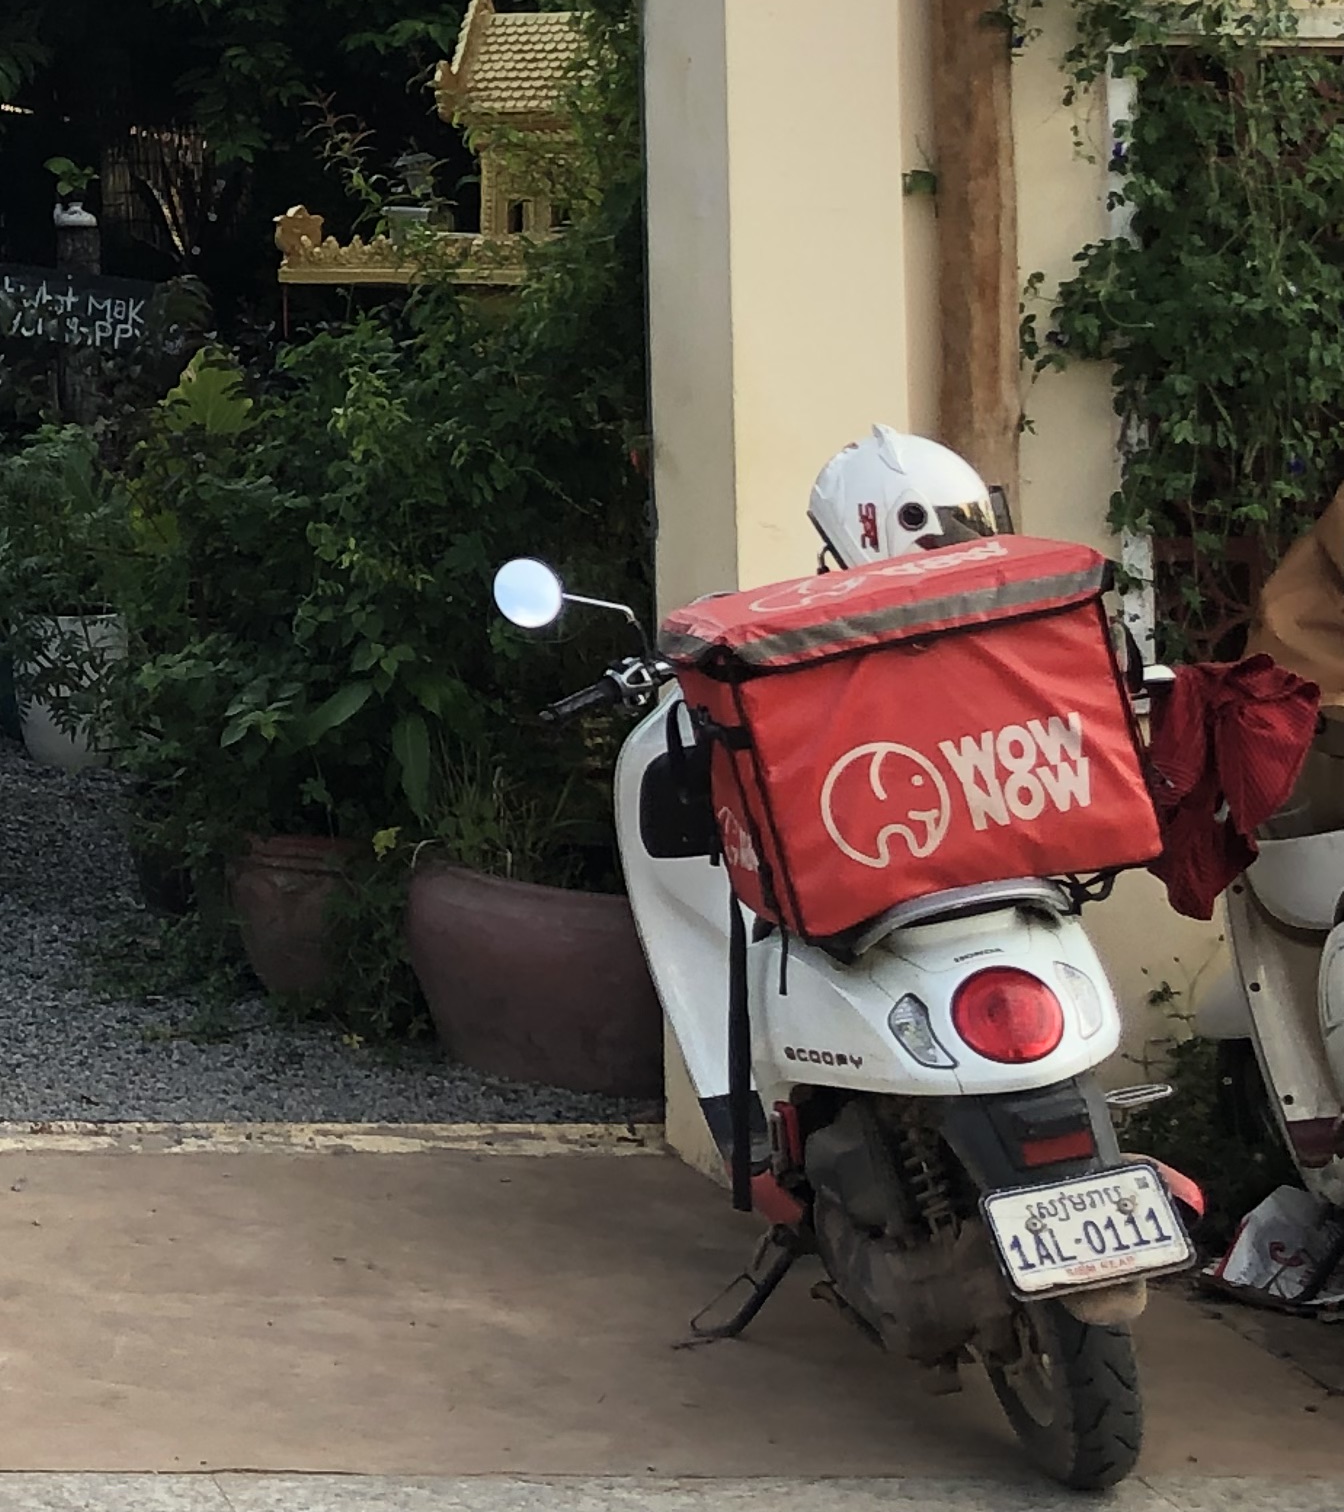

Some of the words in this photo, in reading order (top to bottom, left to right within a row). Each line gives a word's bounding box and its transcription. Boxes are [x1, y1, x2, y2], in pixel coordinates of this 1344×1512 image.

[937, 711, 1083, 781] WOW
[962, 756, 1092, 831] NOW
[784, 1046, 863, 1069] SCOOPY
[1009, 1207, 1172, 1271] 1AL-0111
